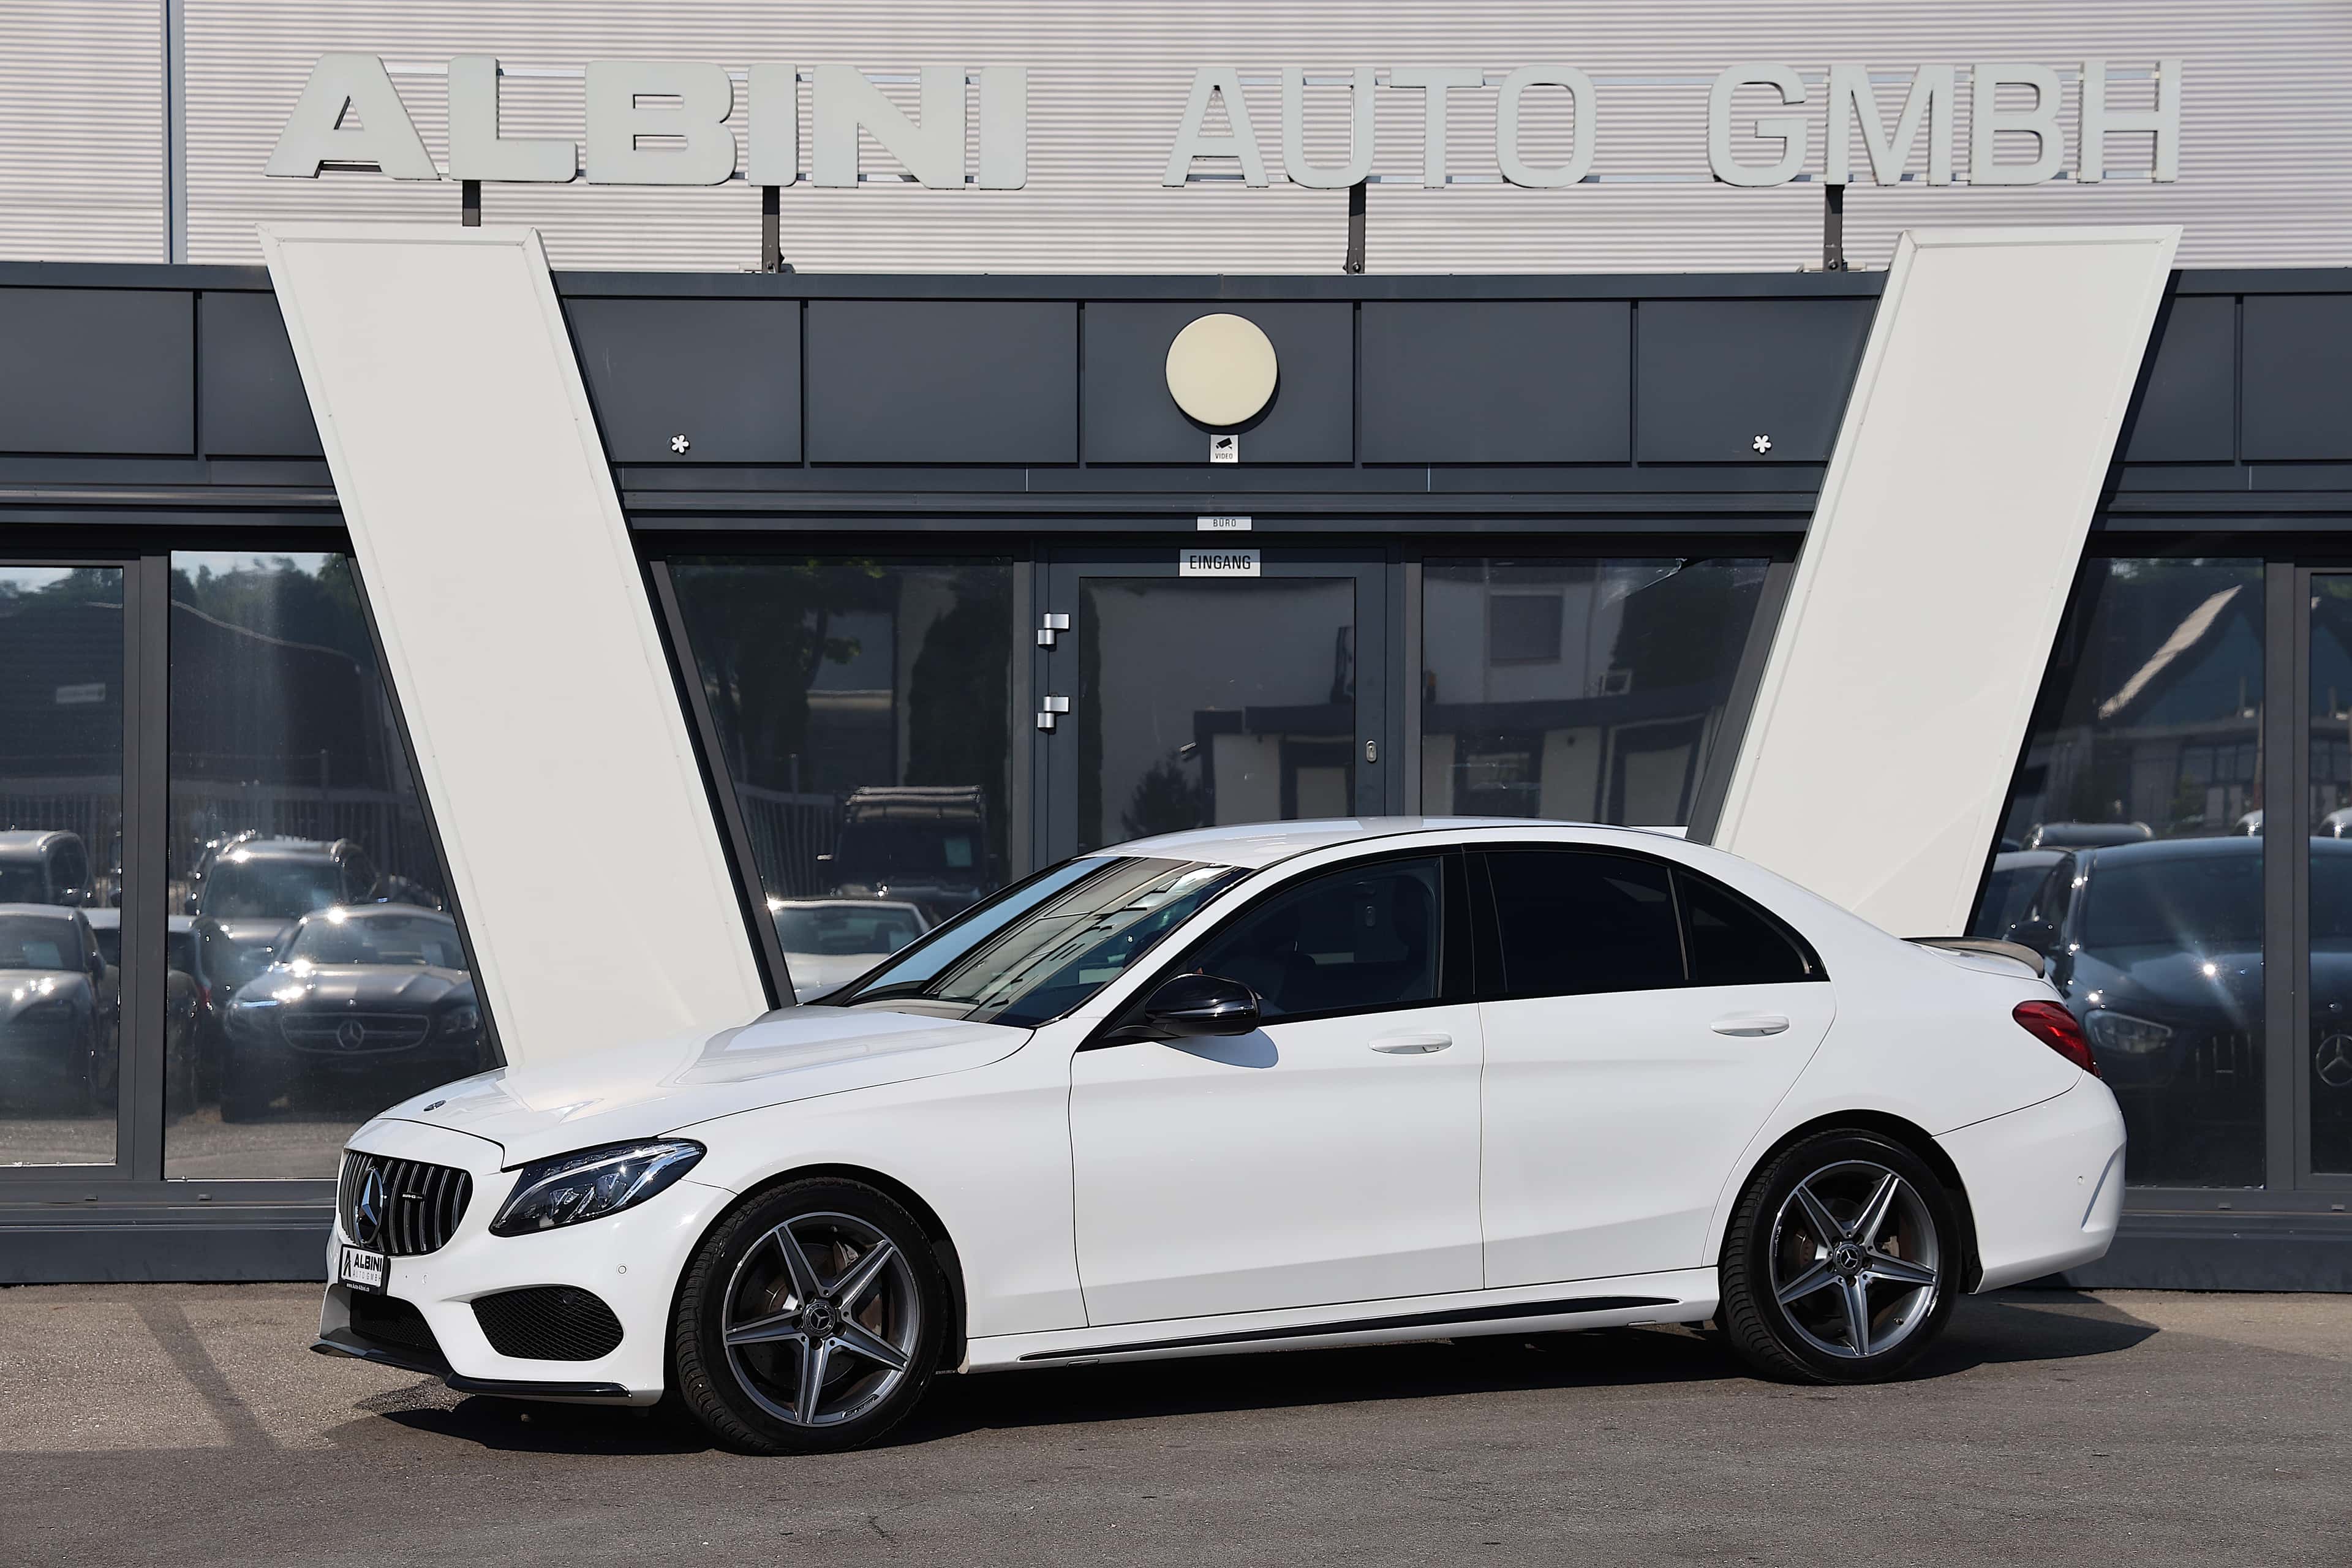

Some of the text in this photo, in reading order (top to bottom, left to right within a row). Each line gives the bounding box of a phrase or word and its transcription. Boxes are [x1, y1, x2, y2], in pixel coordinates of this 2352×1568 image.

[262, 53, 2183, 190] ALBINI AUTO GMBH
[1213, 518, 1237, 527] BÜRO
[1189, 555, 1251, 570] EINGANG
[353, 1253, 383, 1272] ALBINI
